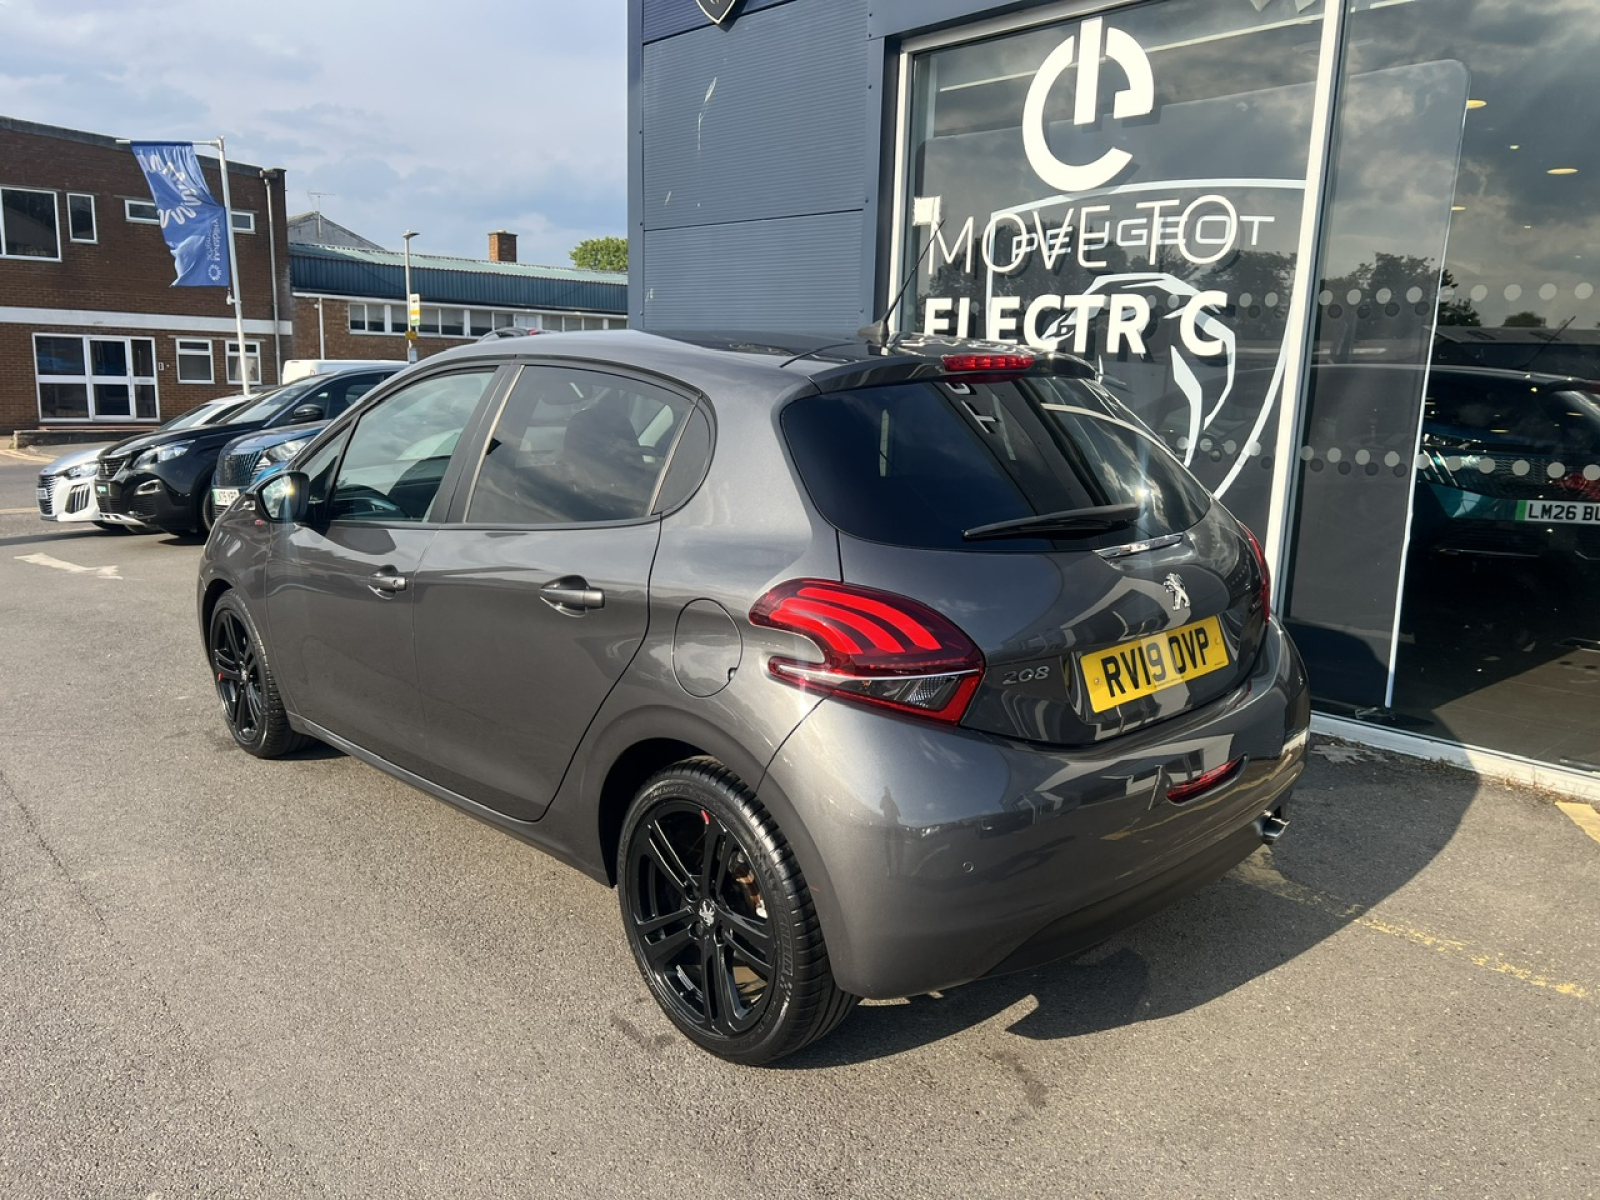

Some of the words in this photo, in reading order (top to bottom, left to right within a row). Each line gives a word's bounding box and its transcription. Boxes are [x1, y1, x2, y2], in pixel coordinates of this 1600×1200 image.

[928, 205, 1111, 275] MOVE
[1136, 195, 1238, 265] TO
[1011, 215, 1275, 261] PEUGEOT
[924, 291, 1228, 356] ELECTRC
[1528, 503, 1577, 520] LM26
[1002, 665, 1050, 685] 208
[1101, 642, 1167, 698] RV19
[1168, 627, 1209, 675] OVP
